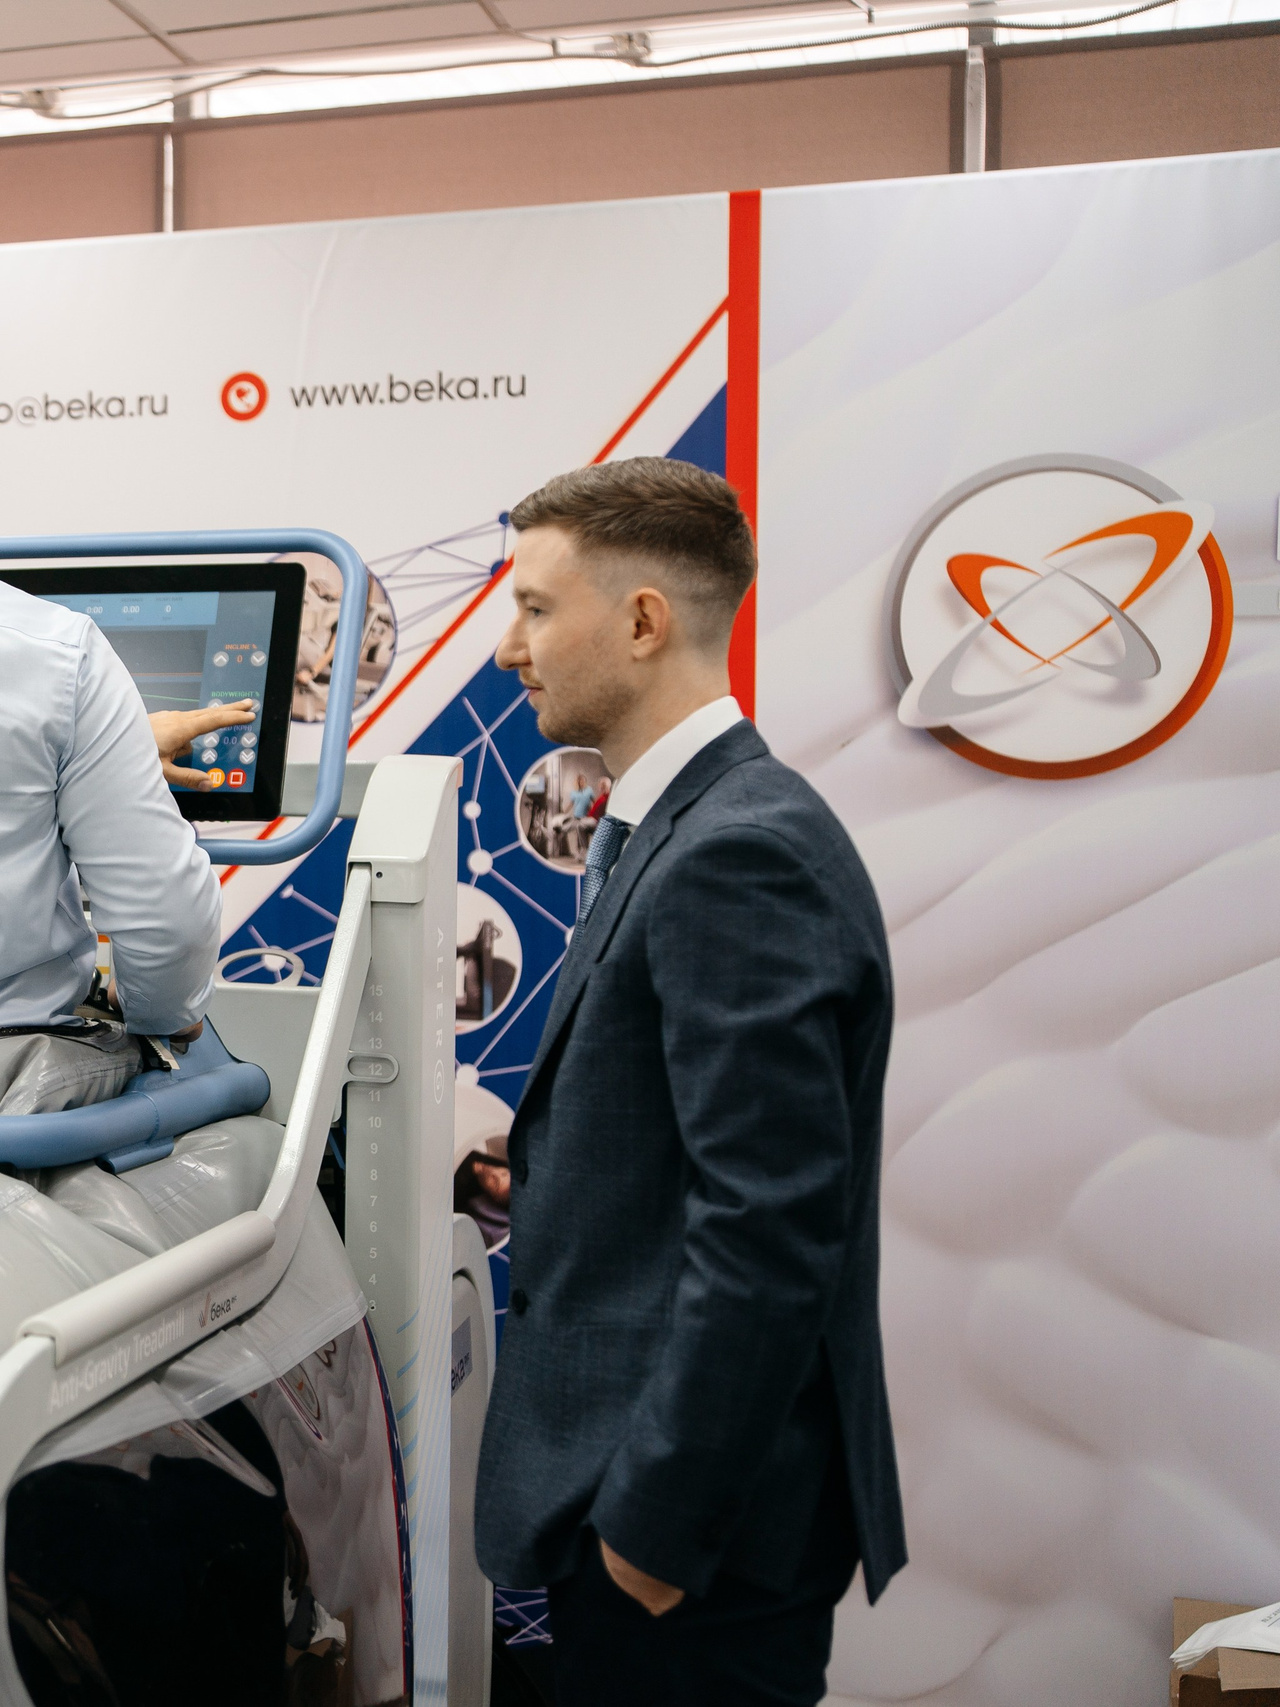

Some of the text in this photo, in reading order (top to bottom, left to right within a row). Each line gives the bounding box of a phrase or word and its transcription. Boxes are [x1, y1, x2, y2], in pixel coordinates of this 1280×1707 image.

[290, 370, 528, 408] www.beka.ru
[236, 655, 243, 664] 0
[211, 690, 254, 699] BODYWEIGHT
[223, 736, 238, 745] 0.0
[369, 984, 384, 997] 15
[368, 1011, 384, 1023] 14
[368, 1037, 383, 1050] 13
[368, 1063, 383, 1076] 12
[368, 1090, 381, 1102] 11
[368, 1116, 382, 1128] 10
[370, 1142, 378, 1154] 9
[370, 1168, 378, 1181] 8
[370, 1195, 378, 1207] 7
[369, 1221, 377, 1233] 6
[369, 1247, 377, 1259] 5
[368, 1273, 377, 1286] 4
[210, 1298, 231, 1321] бека
[133, 1307, 186, 1363] Treadmill
[451, 1359, 465, 1391] ека
